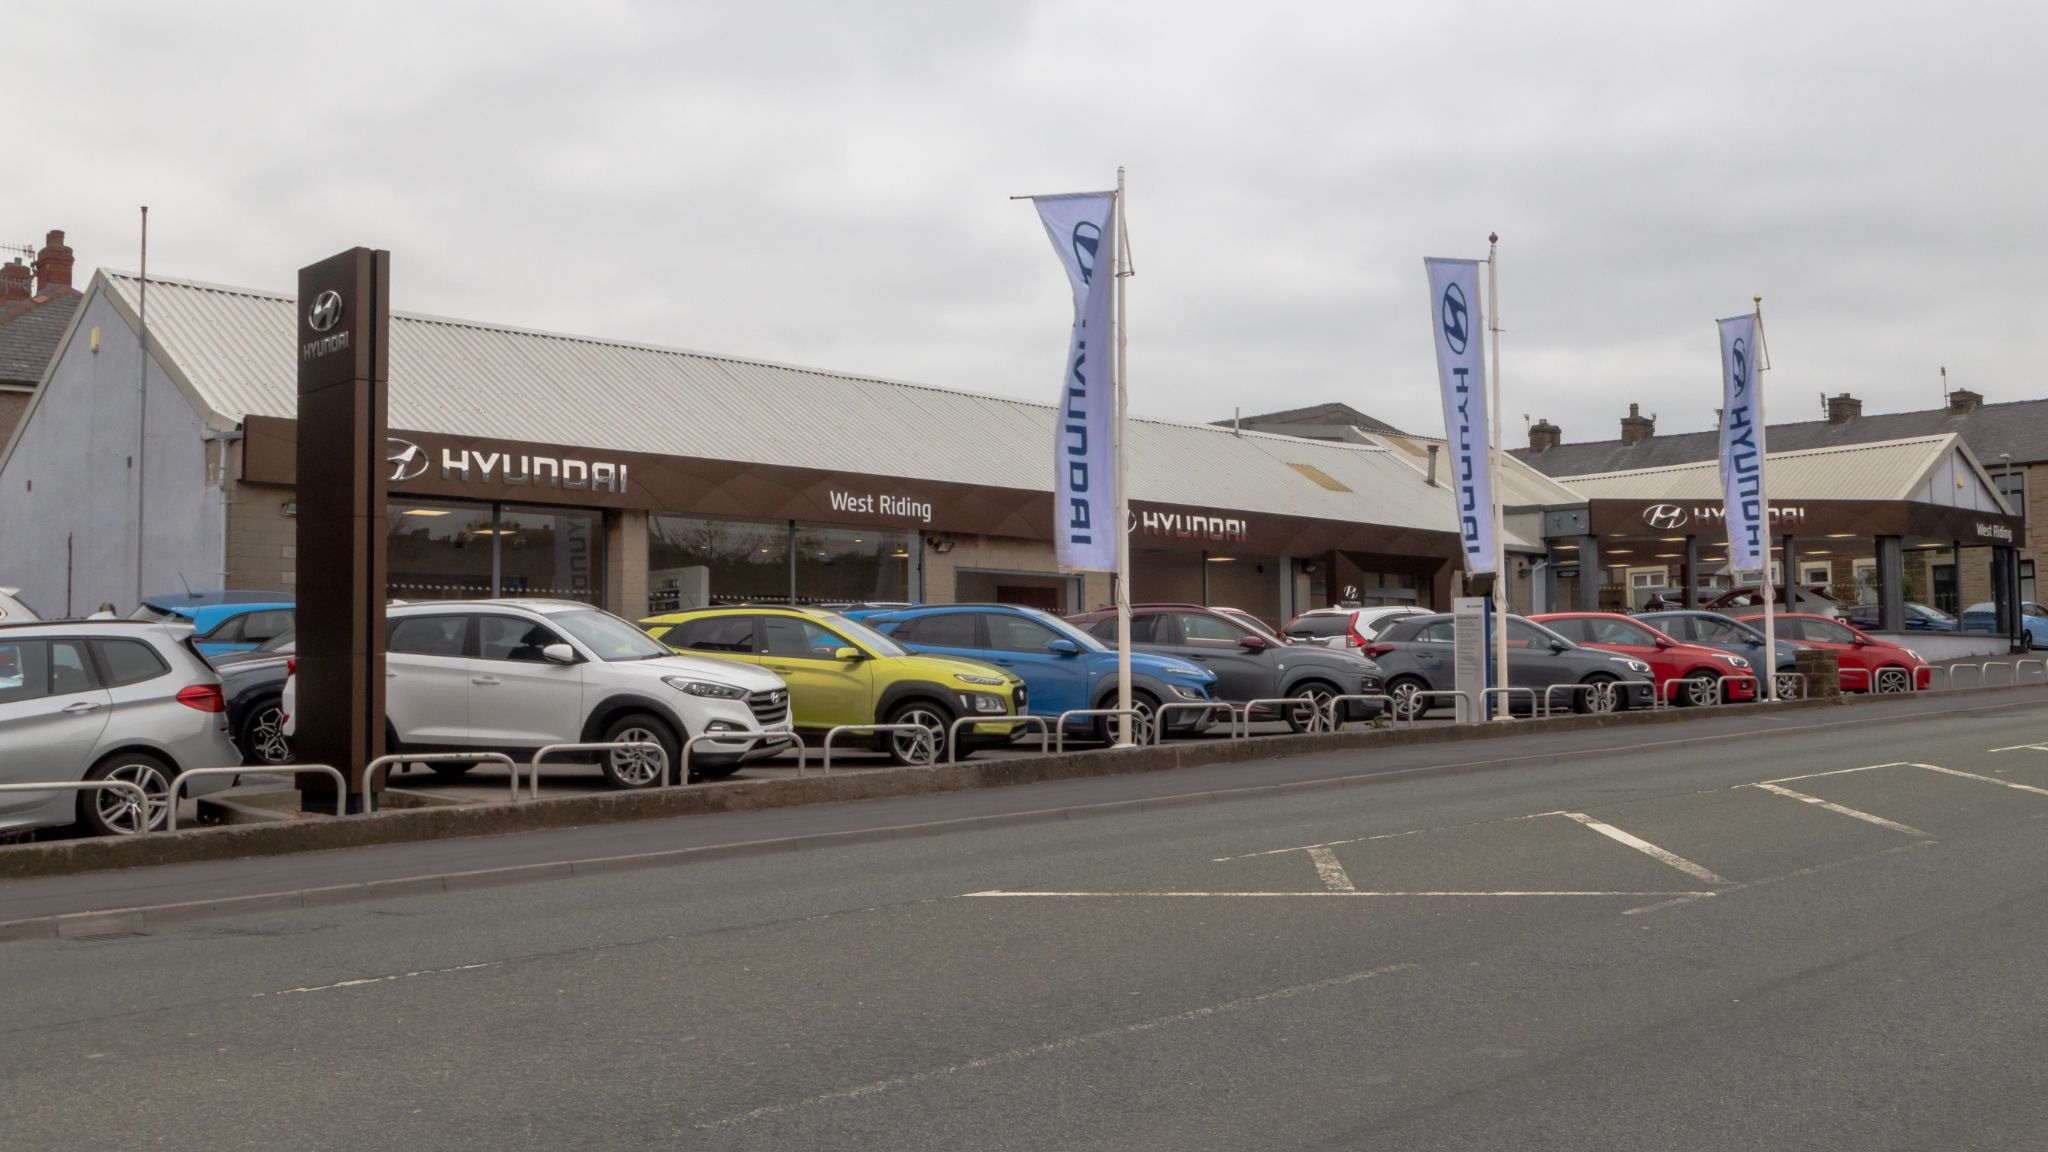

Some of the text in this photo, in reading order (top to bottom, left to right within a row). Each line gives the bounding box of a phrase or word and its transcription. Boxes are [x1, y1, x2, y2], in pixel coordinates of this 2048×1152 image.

[303, 331, 349, 360] HYUNDAI
[442, 448, 627, 494] HYUNDAI
[829, 490, 932, 522] West Riding
[1694, 507, 1805, 526] HYDAI
[1142, 511, 1247, 541] HYUNDAI
[1976, 522, 2013, 543] West Riding
